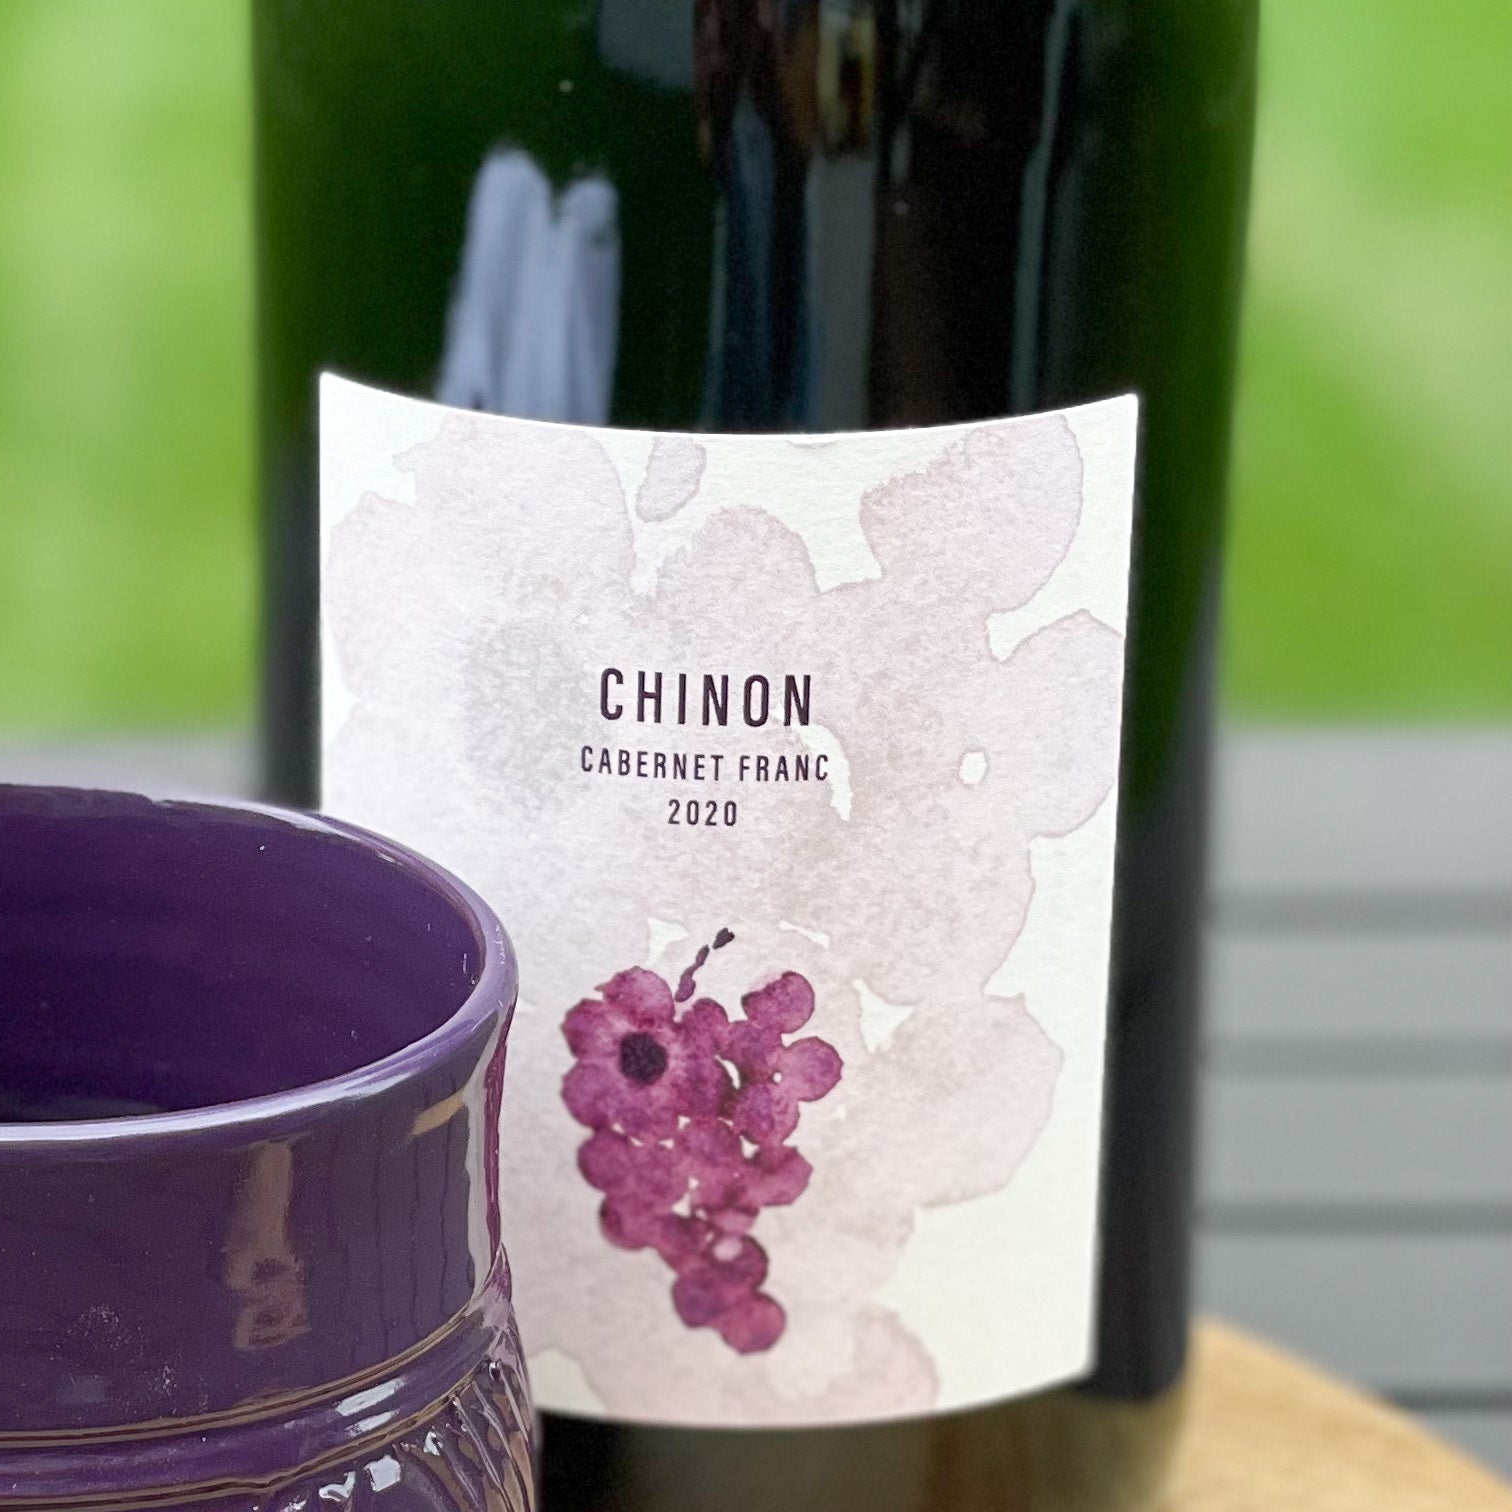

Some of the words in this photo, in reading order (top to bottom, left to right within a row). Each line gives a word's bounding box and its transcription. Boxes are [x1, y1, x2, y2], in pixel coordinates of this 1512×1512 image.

[599, 666, 812, 729] CHINON
[580, 744, 725, 783] CABERNET
[738, 753, 830, 783] FRANC
[667, 798, 738, 828] 2020
